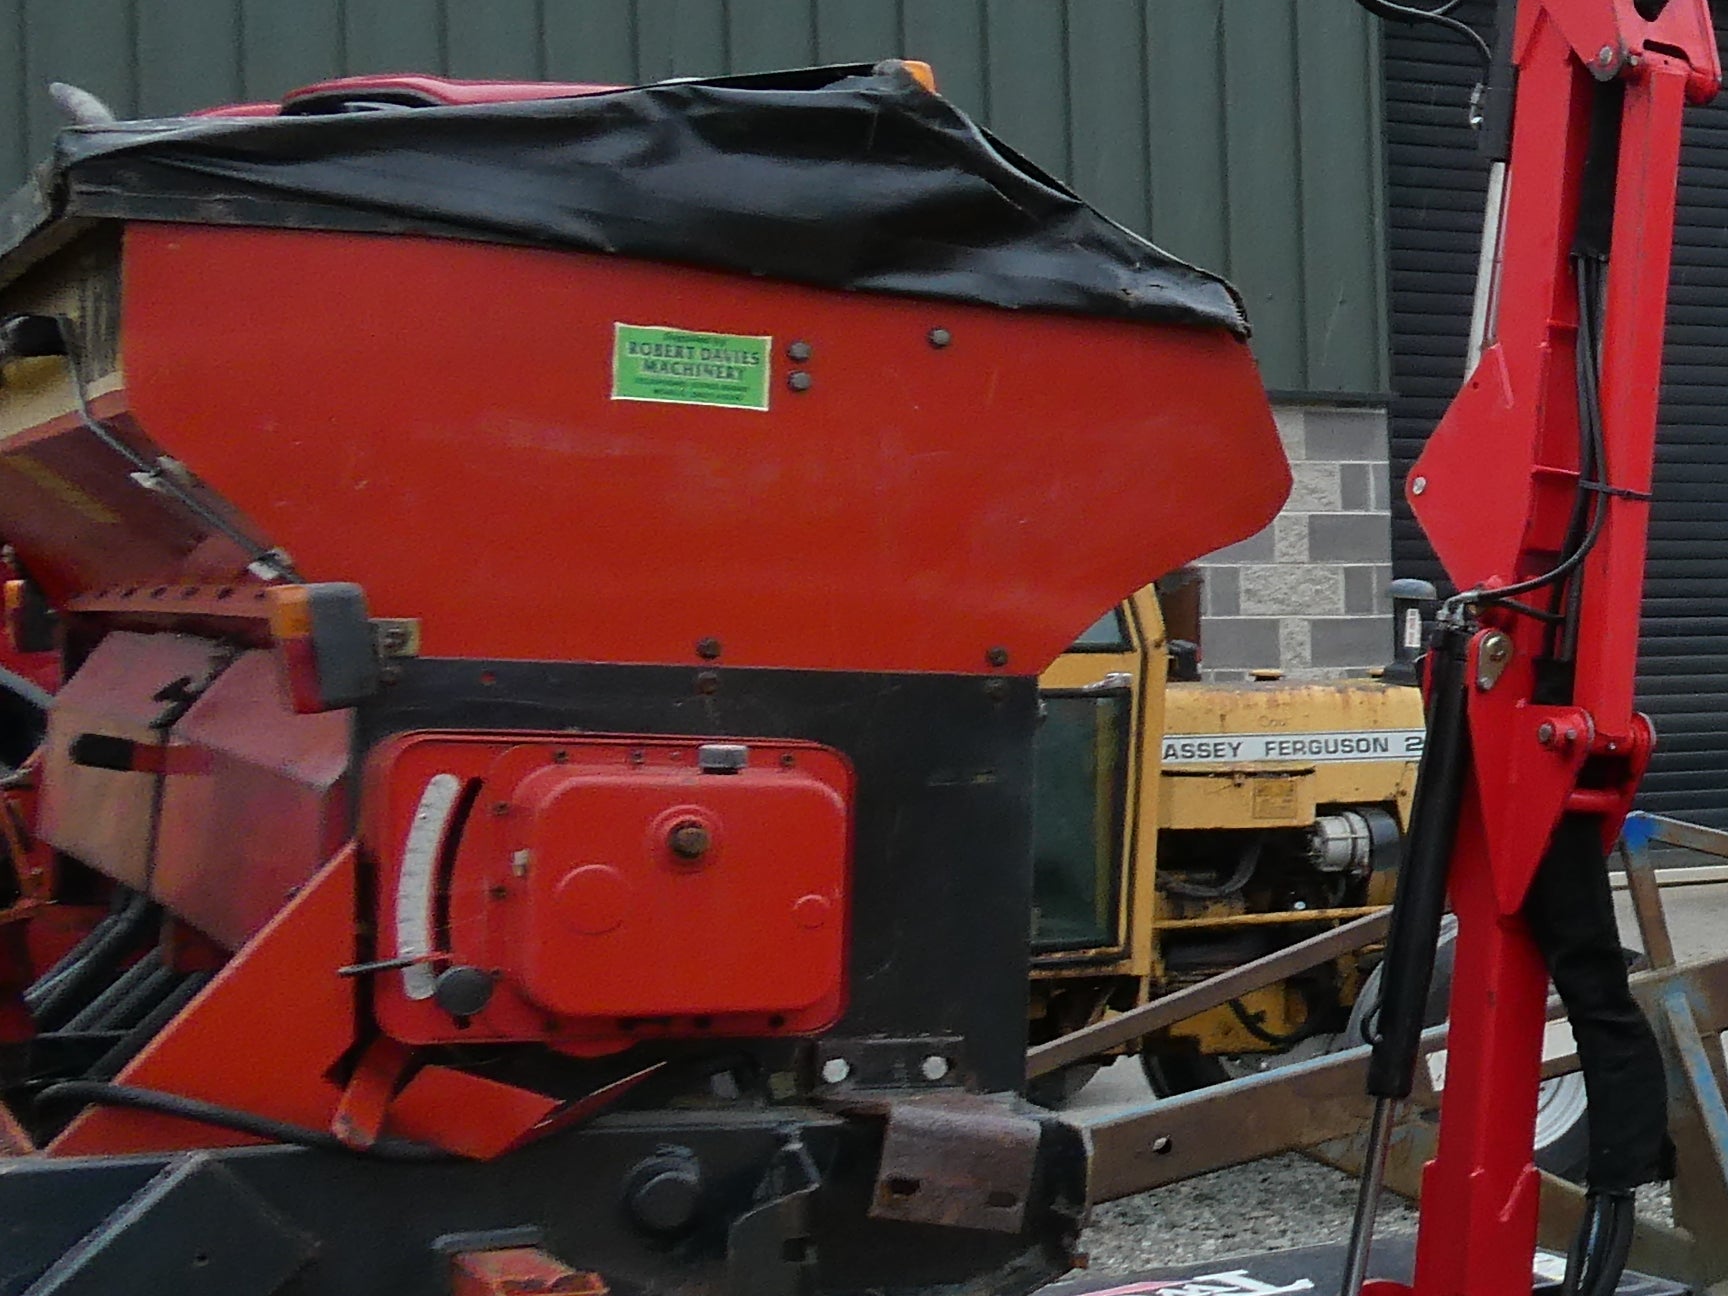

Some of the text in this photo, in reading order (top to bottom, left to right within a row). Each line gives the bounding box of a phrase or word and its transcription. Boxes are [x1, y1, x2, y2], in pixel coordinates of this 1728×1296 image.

[628, 341, 695, 359] ROBERT
[642, 359, 744, 379] MACHINERY
[1163, 741, 1244, 760] ASSEY
[1264, 737, 1389, 757] FERGUSON
